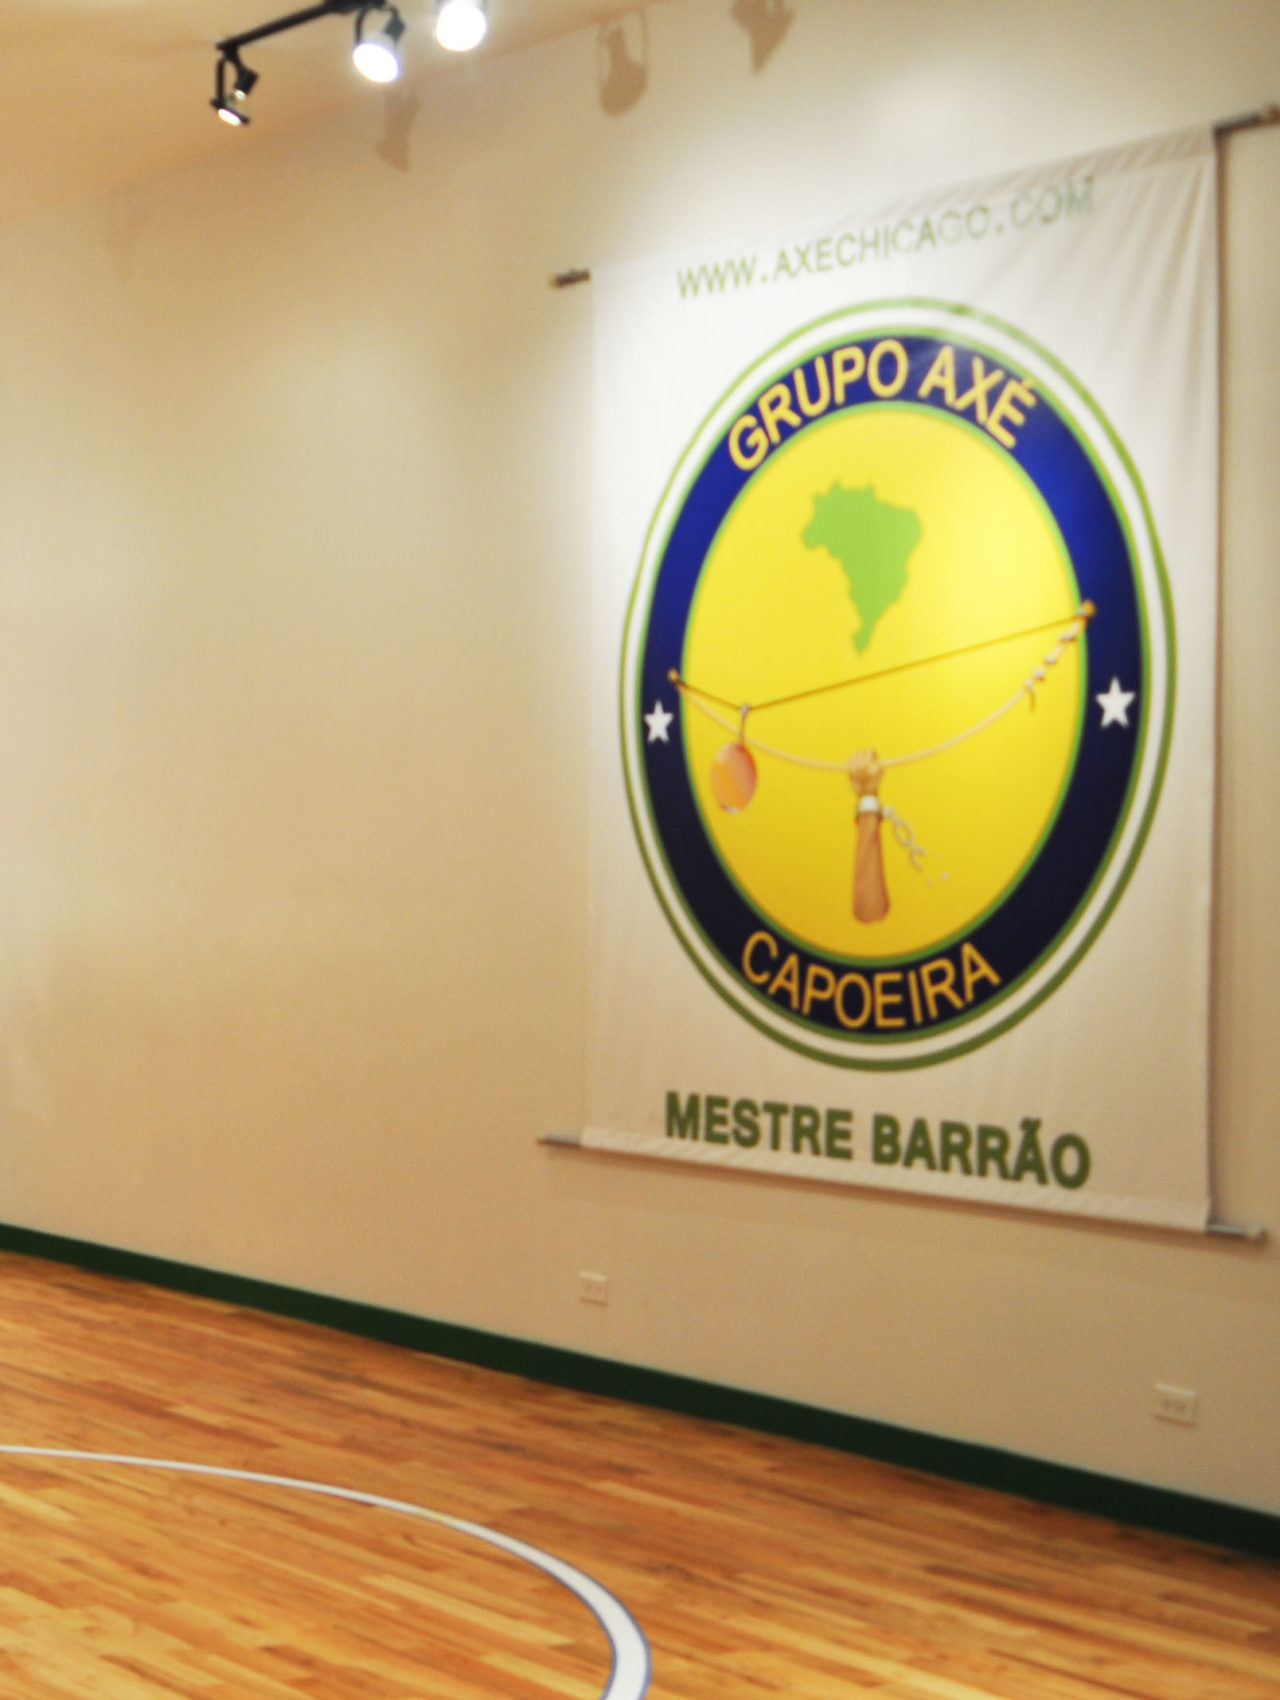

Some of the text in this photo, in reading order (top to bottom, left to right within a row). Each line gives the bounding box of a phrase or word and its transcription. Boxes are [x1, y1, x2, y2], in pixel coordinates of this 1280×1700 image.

[728, 338, 1037, 471] GRUPO AXÉ
[741, 930, 1001, 1029] CAPOEIRA
[665, 1091, 1092, 1190] MESTRE BARRÃO
